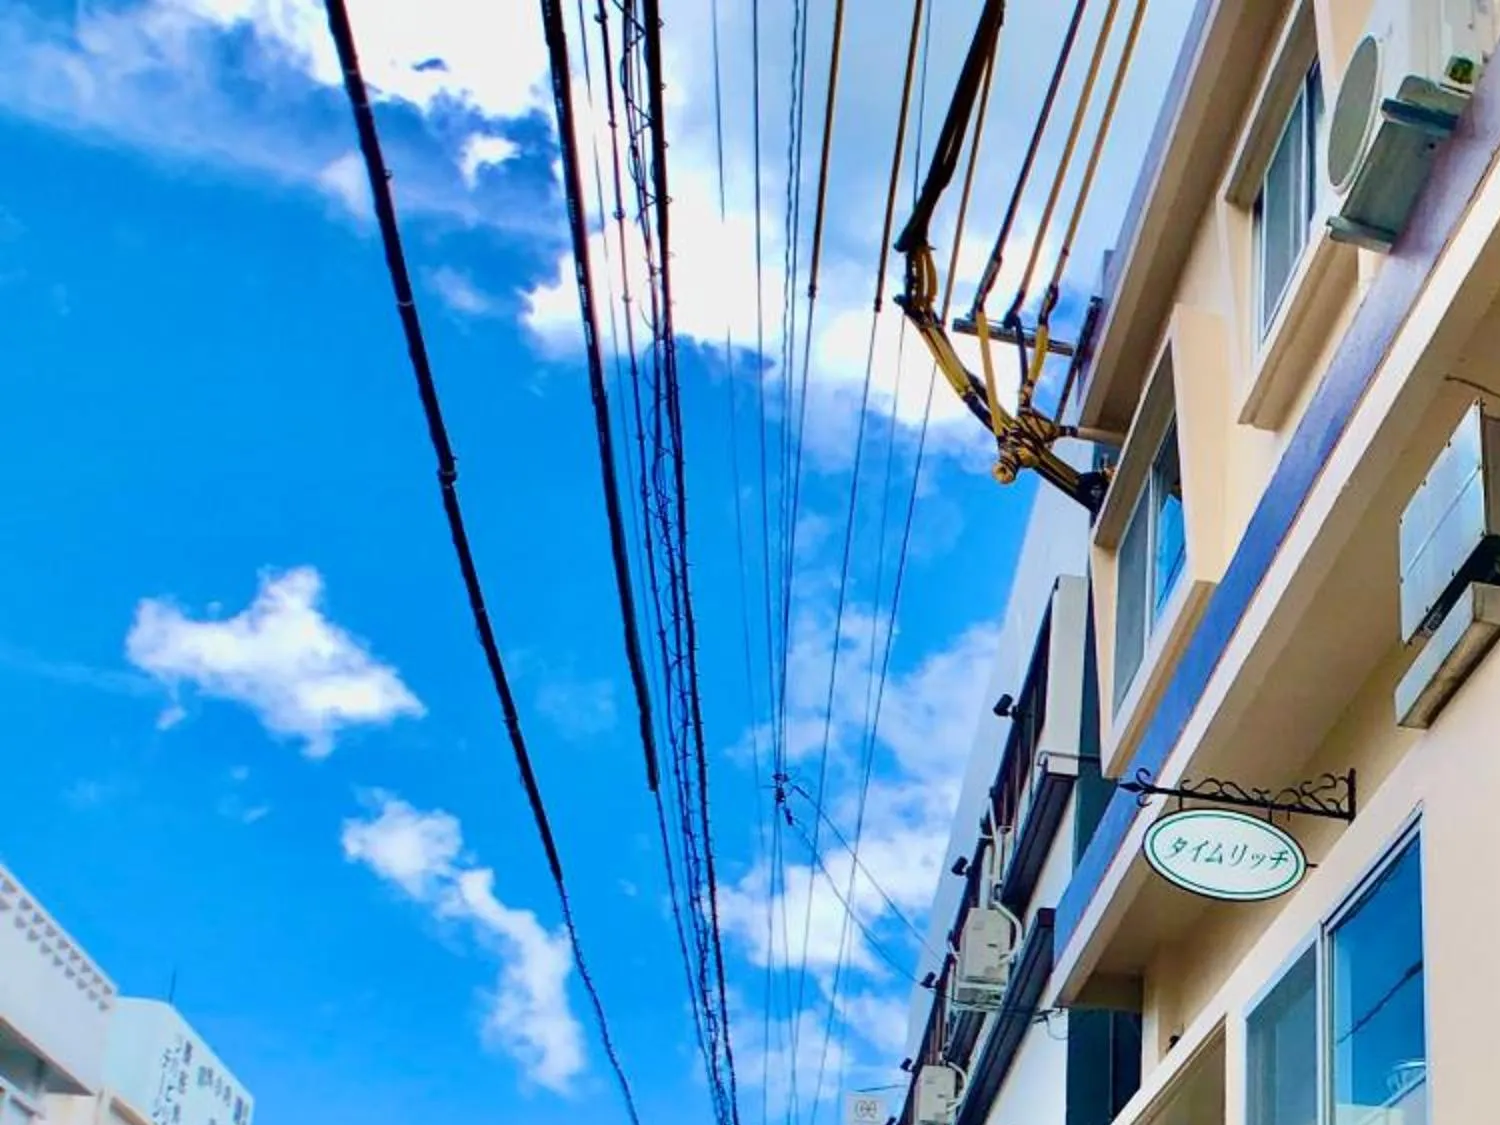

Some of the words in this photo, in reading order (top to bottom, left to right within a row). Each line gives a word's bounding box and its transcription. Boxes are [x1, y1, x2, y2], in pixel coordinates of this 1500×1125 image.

[1165, 835, 1290, 871] タイムリッチ
